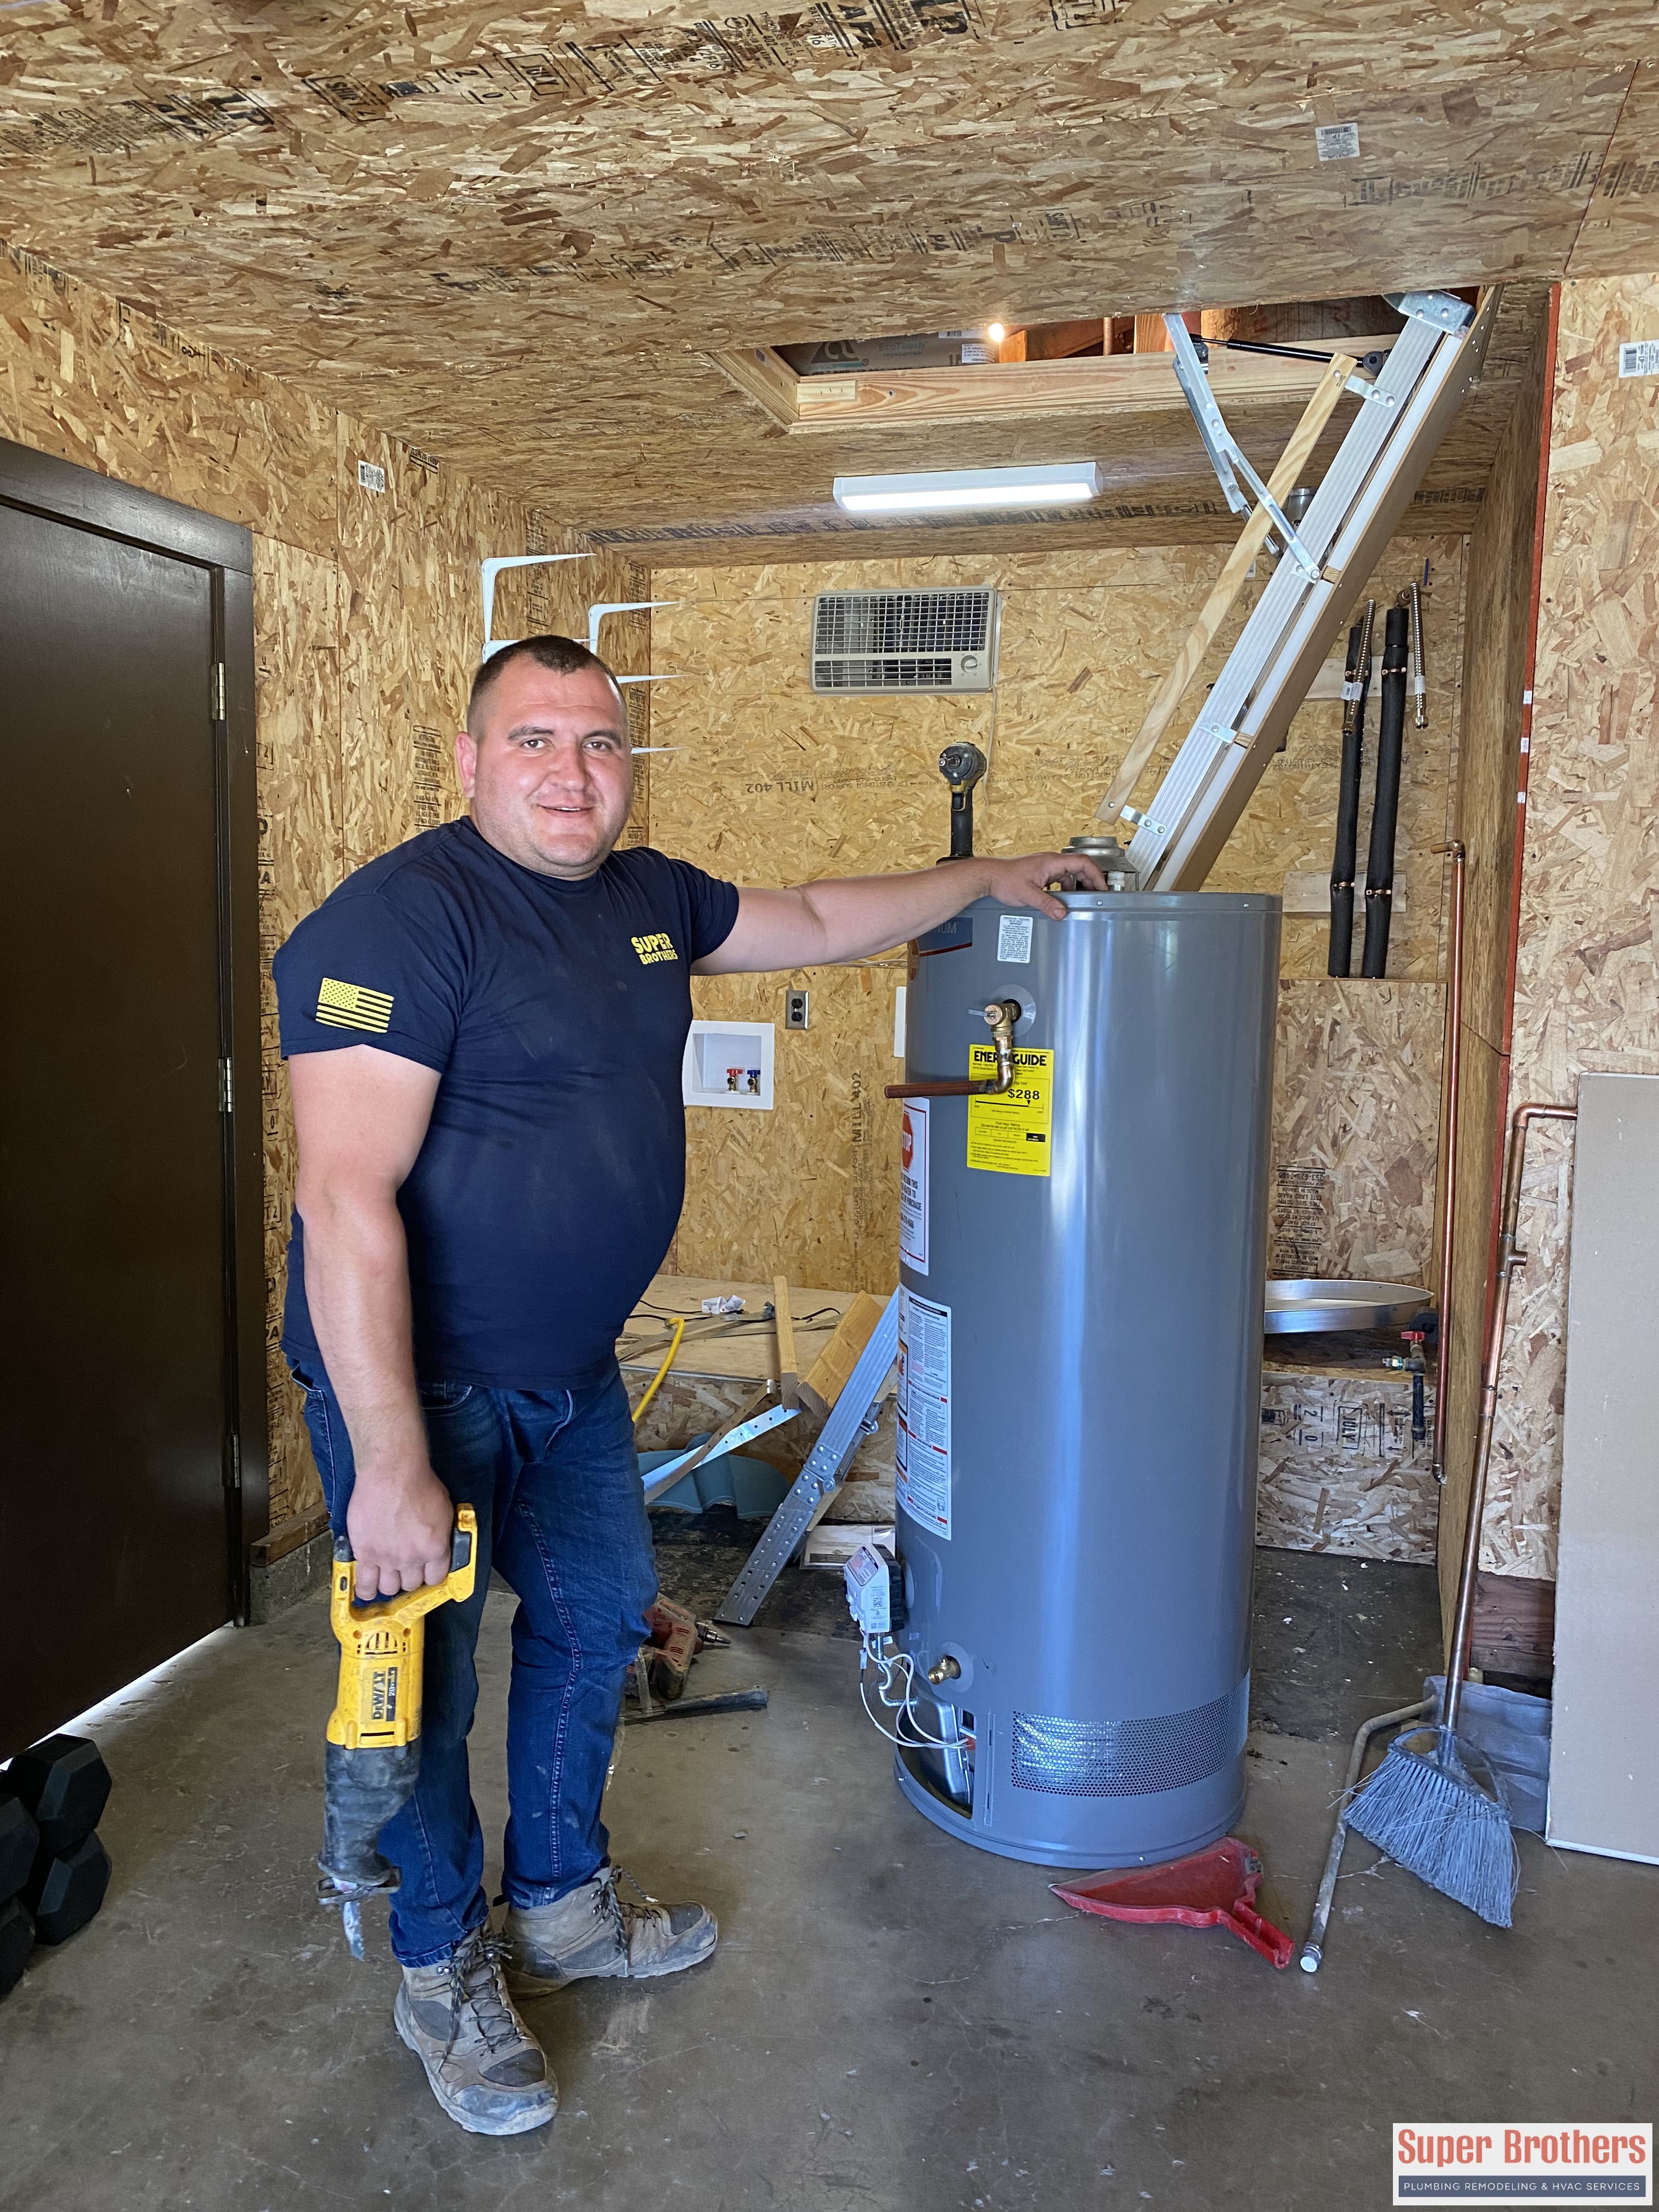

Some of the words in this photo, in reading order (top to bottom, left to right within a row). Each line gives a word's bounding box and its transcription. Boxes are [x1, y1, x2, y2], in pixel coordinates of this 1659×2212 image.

[836, 0, 886, 50] APA
[761, 34, 778, 47] 402
[518, 63, 562, 88] JULY
[321, 80, 369, 108] SHIFT
[1042, 212, 1071, 231] SHIFT
[746, 782, 772, 793] 402
[776, 781, 814, 792] MILL
[631, 933, 673, 953] SUPER
[639, 949, 678, 964] BROTHERS
[851, 1070, 861, 1098] 402
[1008, 1088, 1040, 1099] $288
[851, 1103, 862, 1142] MILL
[1341, 1416, 1356, 1441] JULY
